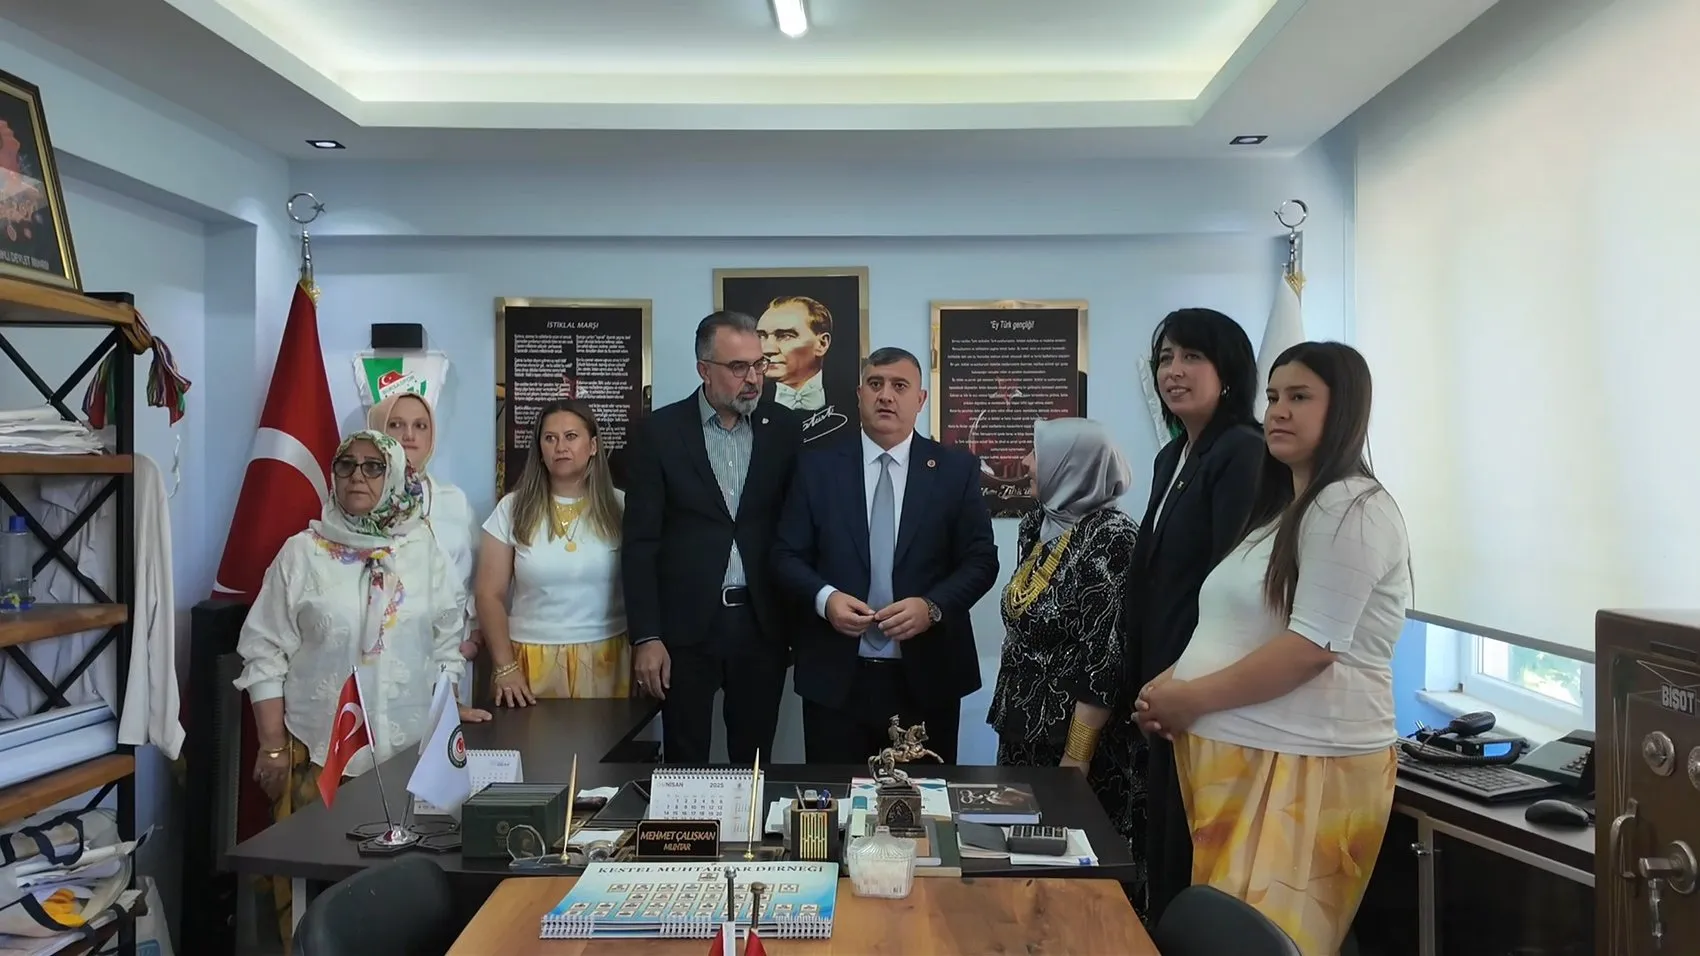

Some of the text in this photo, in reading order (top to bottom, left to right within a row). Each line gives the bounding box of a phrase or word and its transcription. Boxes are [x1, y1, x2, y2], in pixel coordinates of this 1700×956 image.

[1000, 320, 1012, 329] Türk
[640, 830, 716, 842] MEHMET ÇALIŞKAN
[663, 843, 691, 851] MUHTAR
[598, 866, 654, 874] KESTEL
